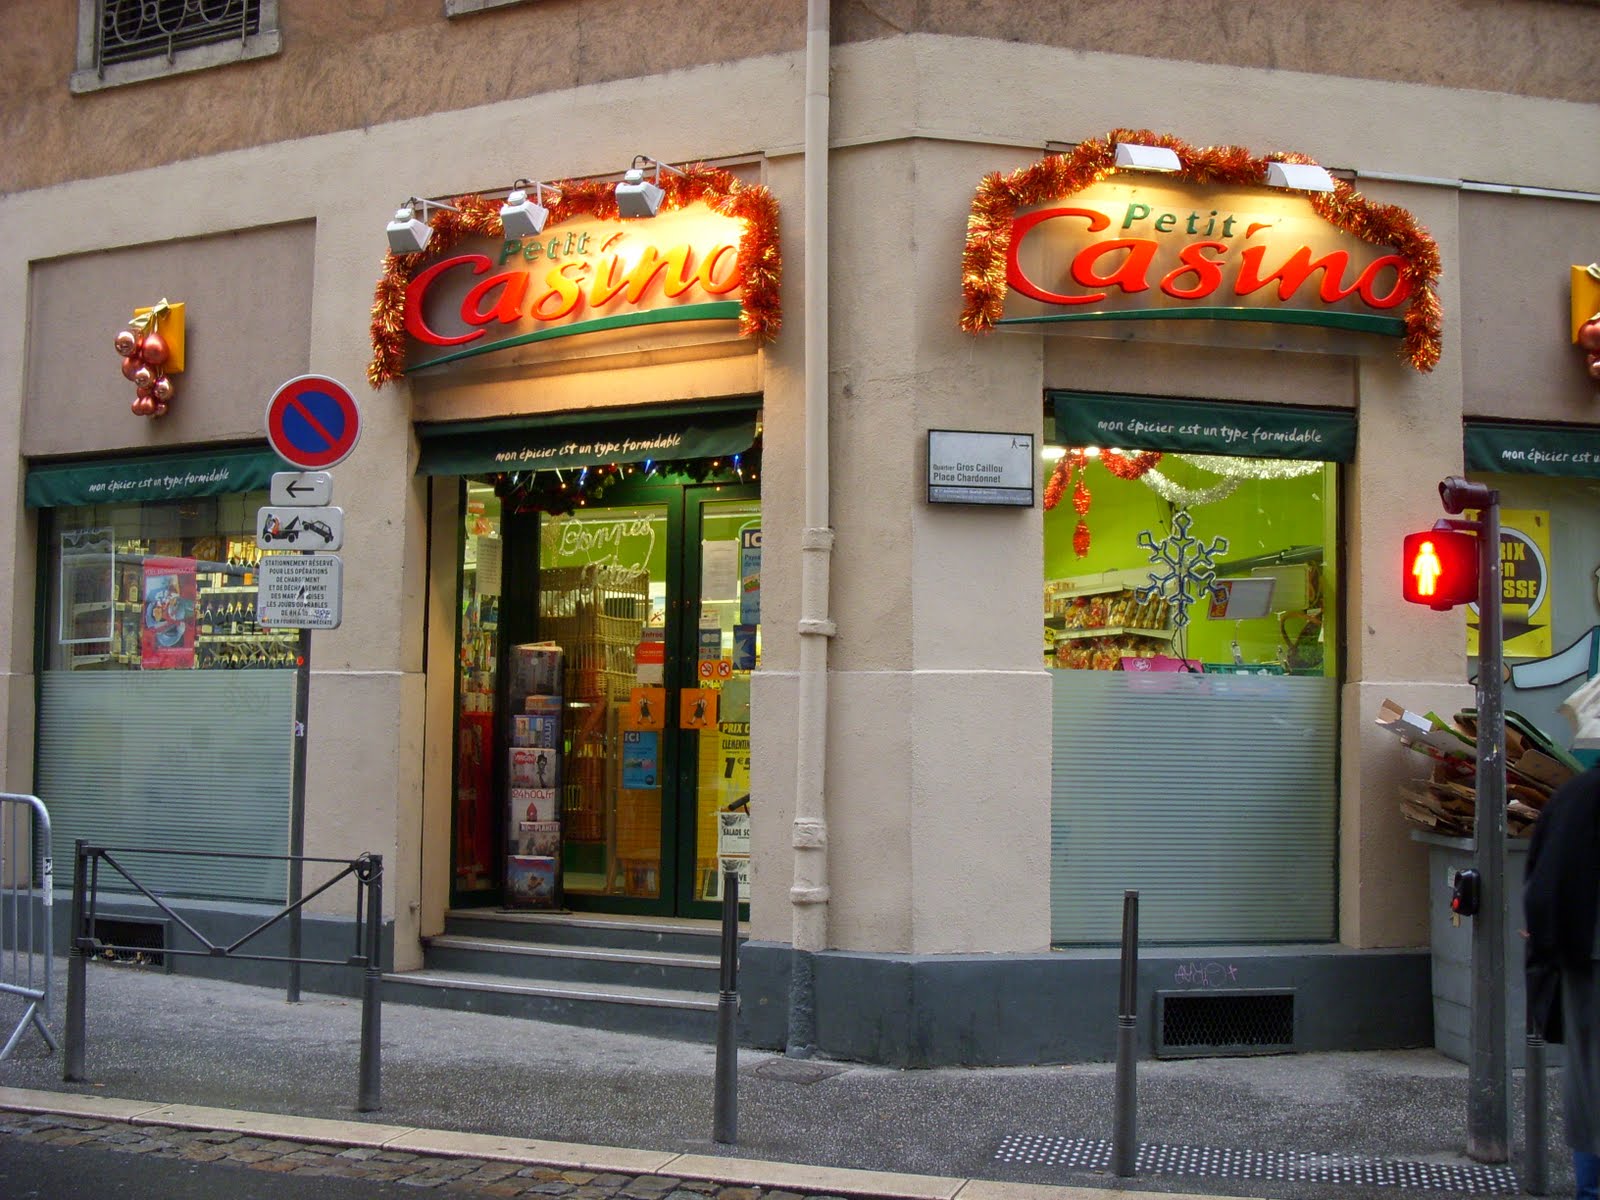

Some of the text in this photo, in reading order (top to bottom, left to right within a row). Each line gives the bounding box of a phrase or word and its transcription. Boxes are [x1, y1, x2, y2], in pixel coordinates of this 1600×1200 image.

[1122, 203, 1237, 238] Petit
[498, 231, 591, 265] Petit
[1005, 207, 1416, 309] Casino
[404, 232, 743, 346] Casino
[1097, 418, 1322, 444] mon épicier est un type formidable
[495, 432, 682, 462] mon épicier est un type formidable
[1502, 450, 1525, 461] mon
[1527, 447, 1569, 464] épicier
[1572, 452, 1592, 463] est
[956, 463, 975, 472] Gros
[975, 463, 1003, 473] Caillou
[89, 468, 230, 493] mon épicier est un type formidable
[933, 472, 1001, 483] Place Chardonnet
[744, 531, 761, 548] IC
[1503, 580, 1537, 598] SSE
[722, 723, 742, 734] PRIX
[624, 733, 640, 742] ICI
[722, 740, 750, 749] CLEMENTIN
[723, 828, 742, 836] SALADE
